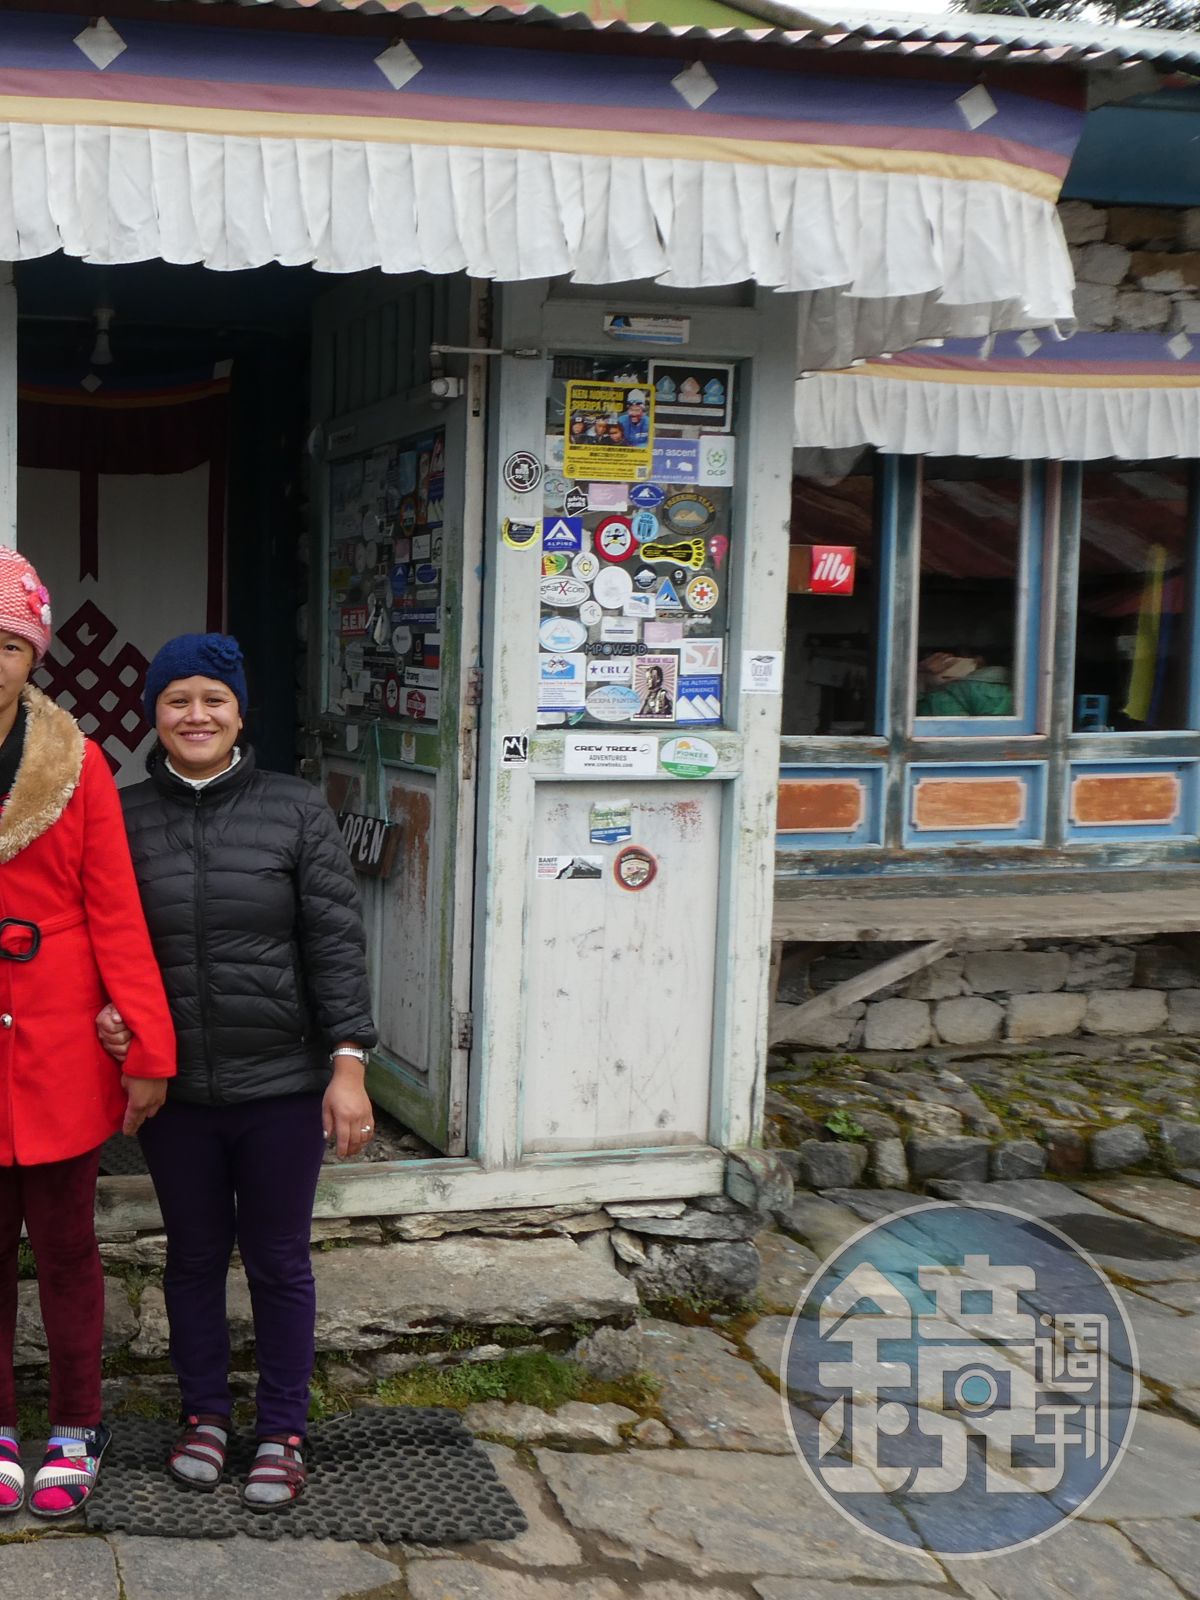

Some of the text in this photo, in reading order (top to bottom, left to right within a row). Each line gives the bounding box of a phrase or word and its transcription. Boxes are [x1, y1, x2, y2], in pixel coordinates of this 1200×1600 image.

[665, 448, 697, 457] ascent
[813, 552, 851, 588] illy
[585, 643, 647, 655] MPOWERD
[600, 666, 630, 674] CRUZ
[341, 813, 386, 864] OPEN
